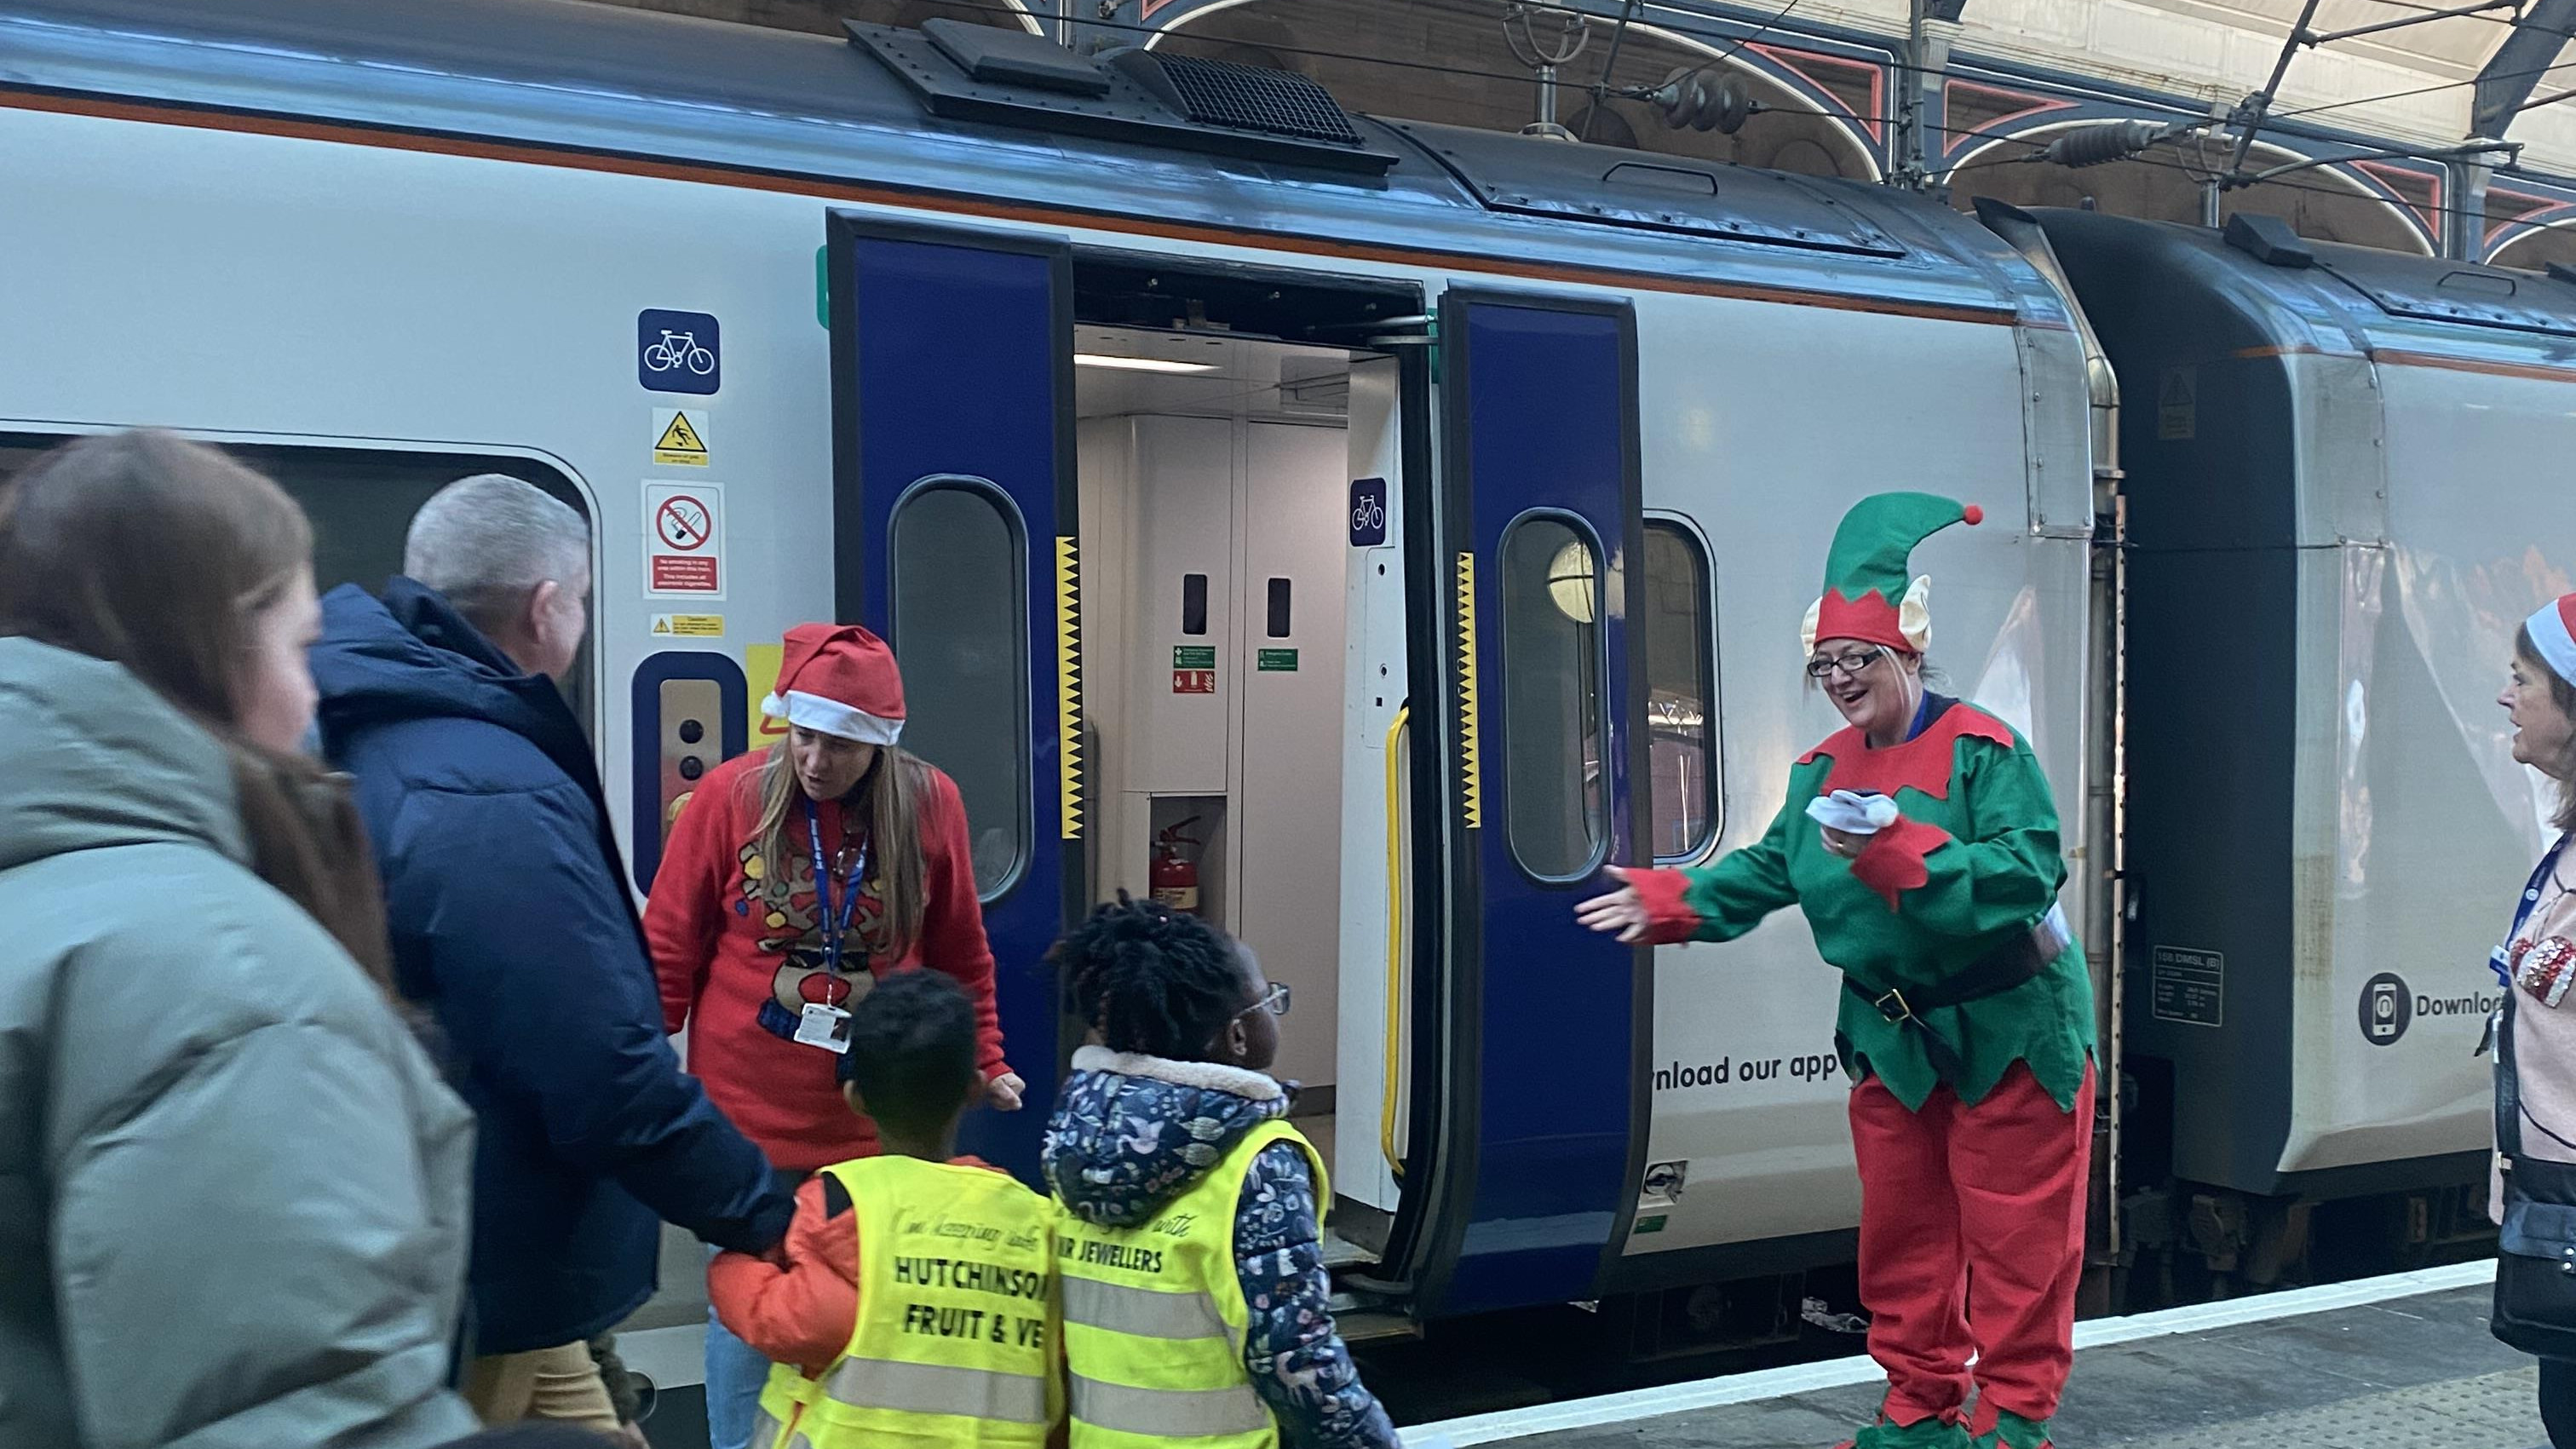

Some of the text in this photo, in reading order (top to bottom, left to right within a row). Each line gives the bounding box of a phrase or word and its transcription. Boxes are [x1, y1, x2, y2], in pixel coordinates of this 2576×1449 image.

[1652, 1054, 1837, 1090] nload our app
[1078, 1239, 1162, 1274] JEWELLERS
[903, 1303, 985, 1339] FRUIT
[991, 1313, 1005, 1343] &
